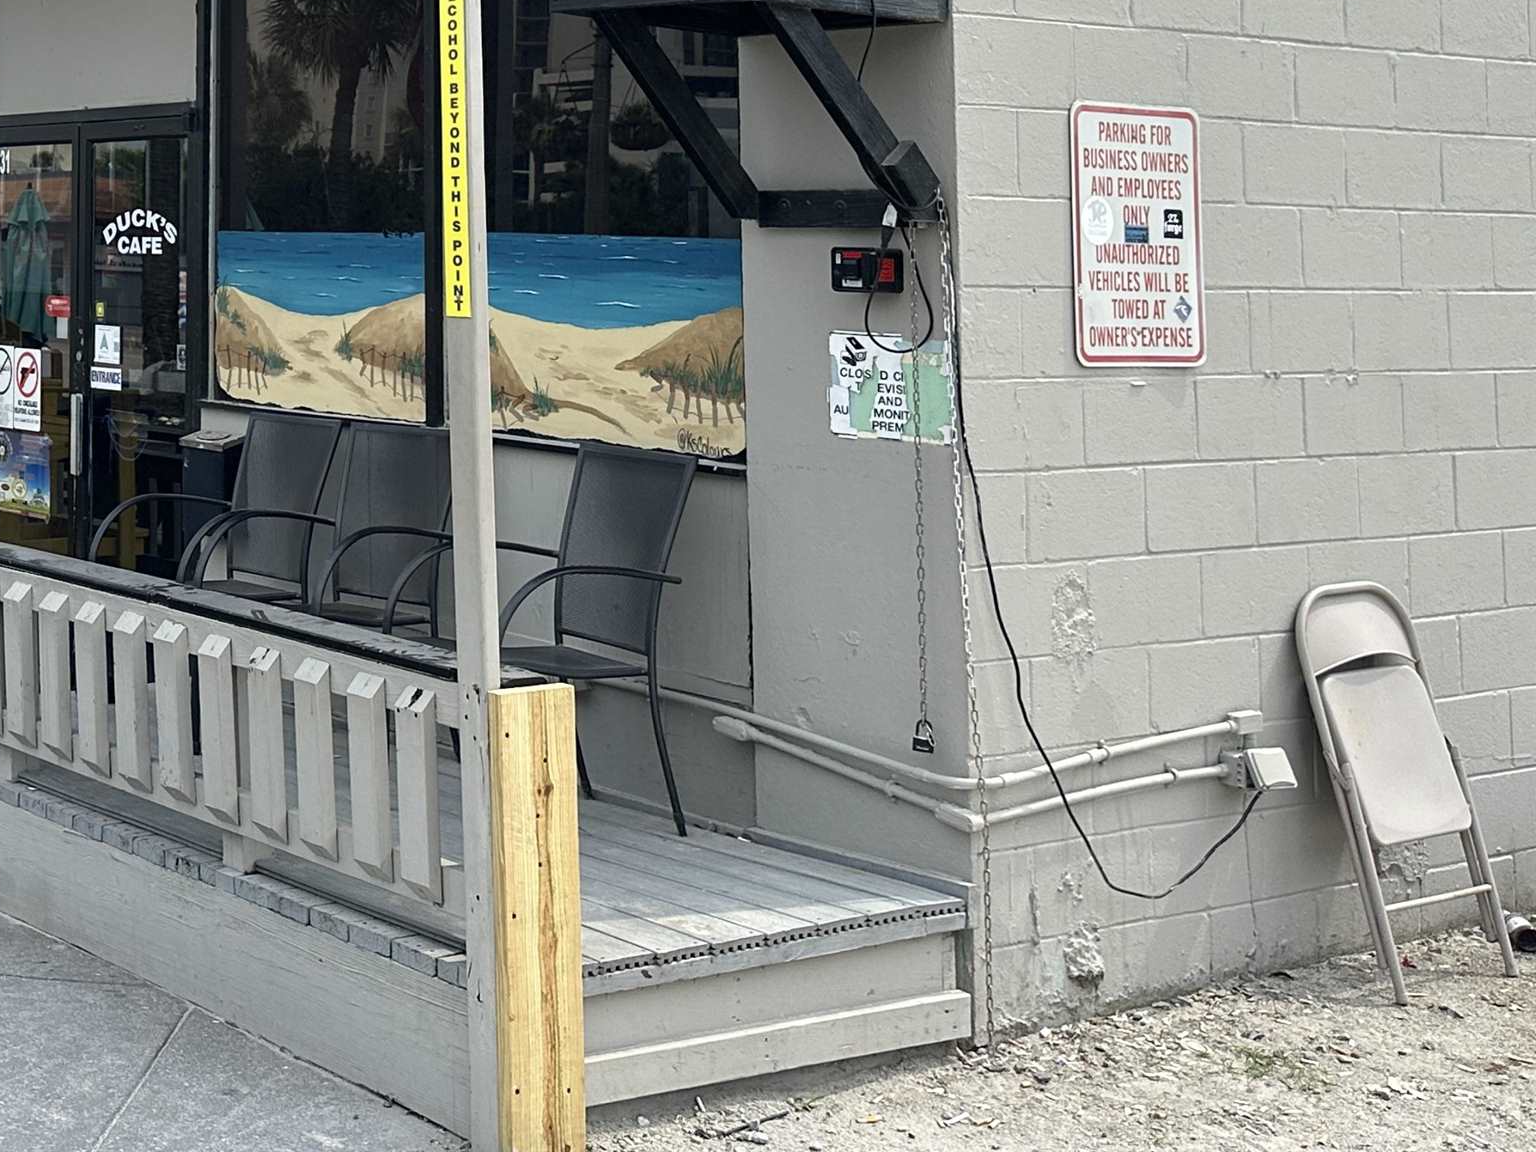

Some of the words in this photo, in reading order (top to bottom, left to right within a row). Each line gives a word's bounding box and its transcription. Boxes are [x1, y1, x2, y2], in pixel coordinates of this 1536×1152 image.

[450, 84, 461, 168] BEYOND
[1098, 121, 1146, 145] PARKING
[1150, 125, 1172, 146] FOR
[1083, 148, 1137, 171] BUSINESS
[1141, 151, 1189, 174] OWNERS
[1091, 176, 1114, 197] AND
[1117, 177, 1182, 200] EMPLOYEES
[451, 176, 462, 232] THIS
[1122, 204, 1151, 226] ONLY
[102, 208, 178, 246] DUCK'S
[117, 235, 164, 255] CAFE
[1096, 243, 1180, 266] UNAUTHORIZED
[452, 240, 464, 312] POINT
[1088, 270, 1141, 293] VEHICLES
[1143, 271, 1171, 293] WILL
[1174, 273, 1190, 294] BE
[1112, 298, 1149, 320] TOWED
[1152, 299, 1166, 320] AT
[1089, 325, 1138, 348] OWNER'S
[1141, 326, 1193, 348] EXPENSE
[91, 370, 121, 385] ENTRANCE
[877, 396, 903, 407] AND
